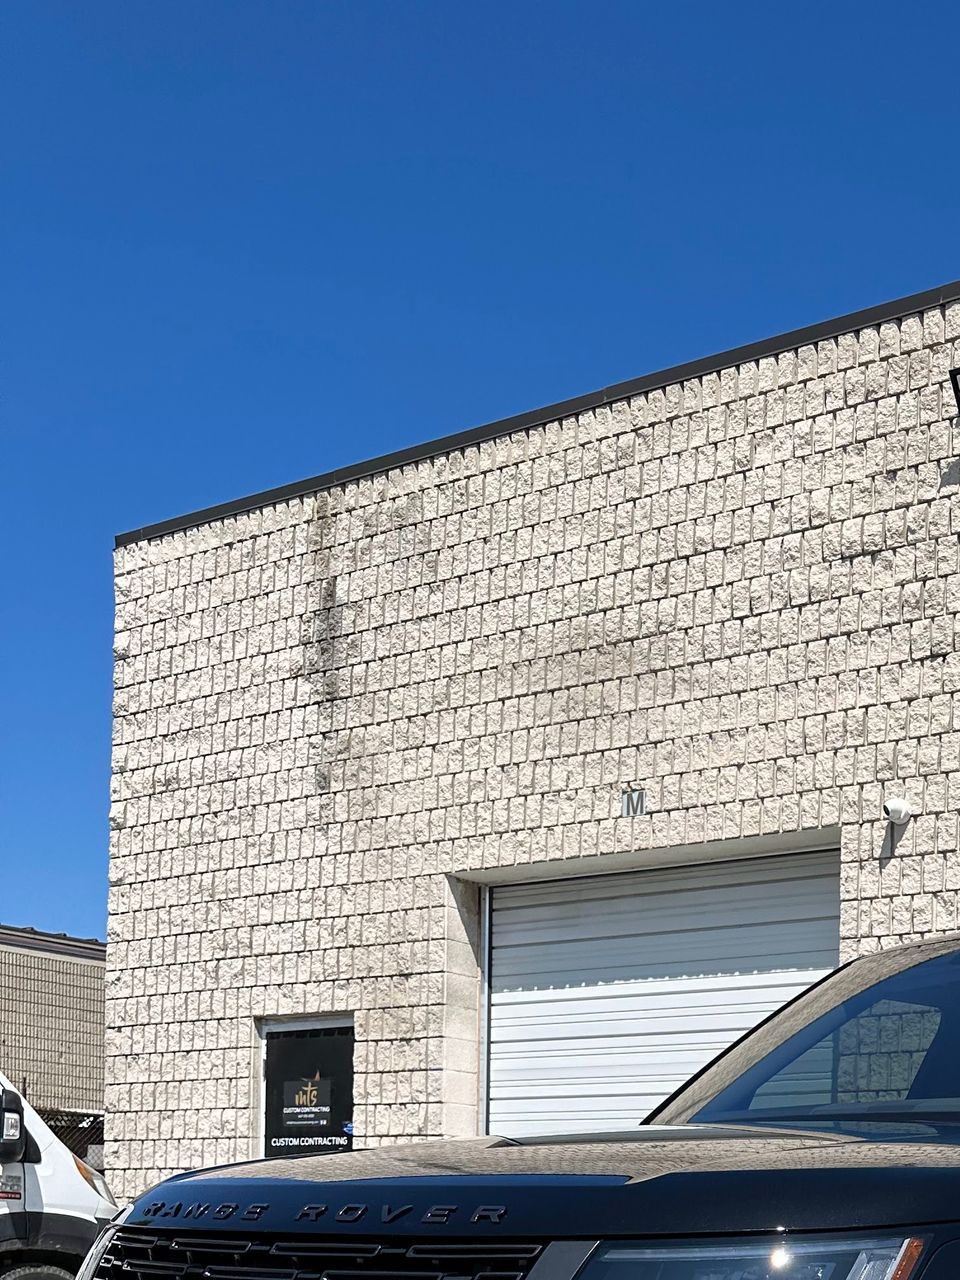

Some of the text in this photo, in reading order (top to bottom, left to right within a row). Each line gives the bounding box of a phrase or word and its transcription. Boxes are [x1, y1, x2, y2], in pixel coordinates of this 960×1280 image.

[627, 792, 644, 815] M
[271, 1137, 348, 1146] CUSTOM CONTRACTING
[142, 1201, 511, 1225] RANGE ROVER
